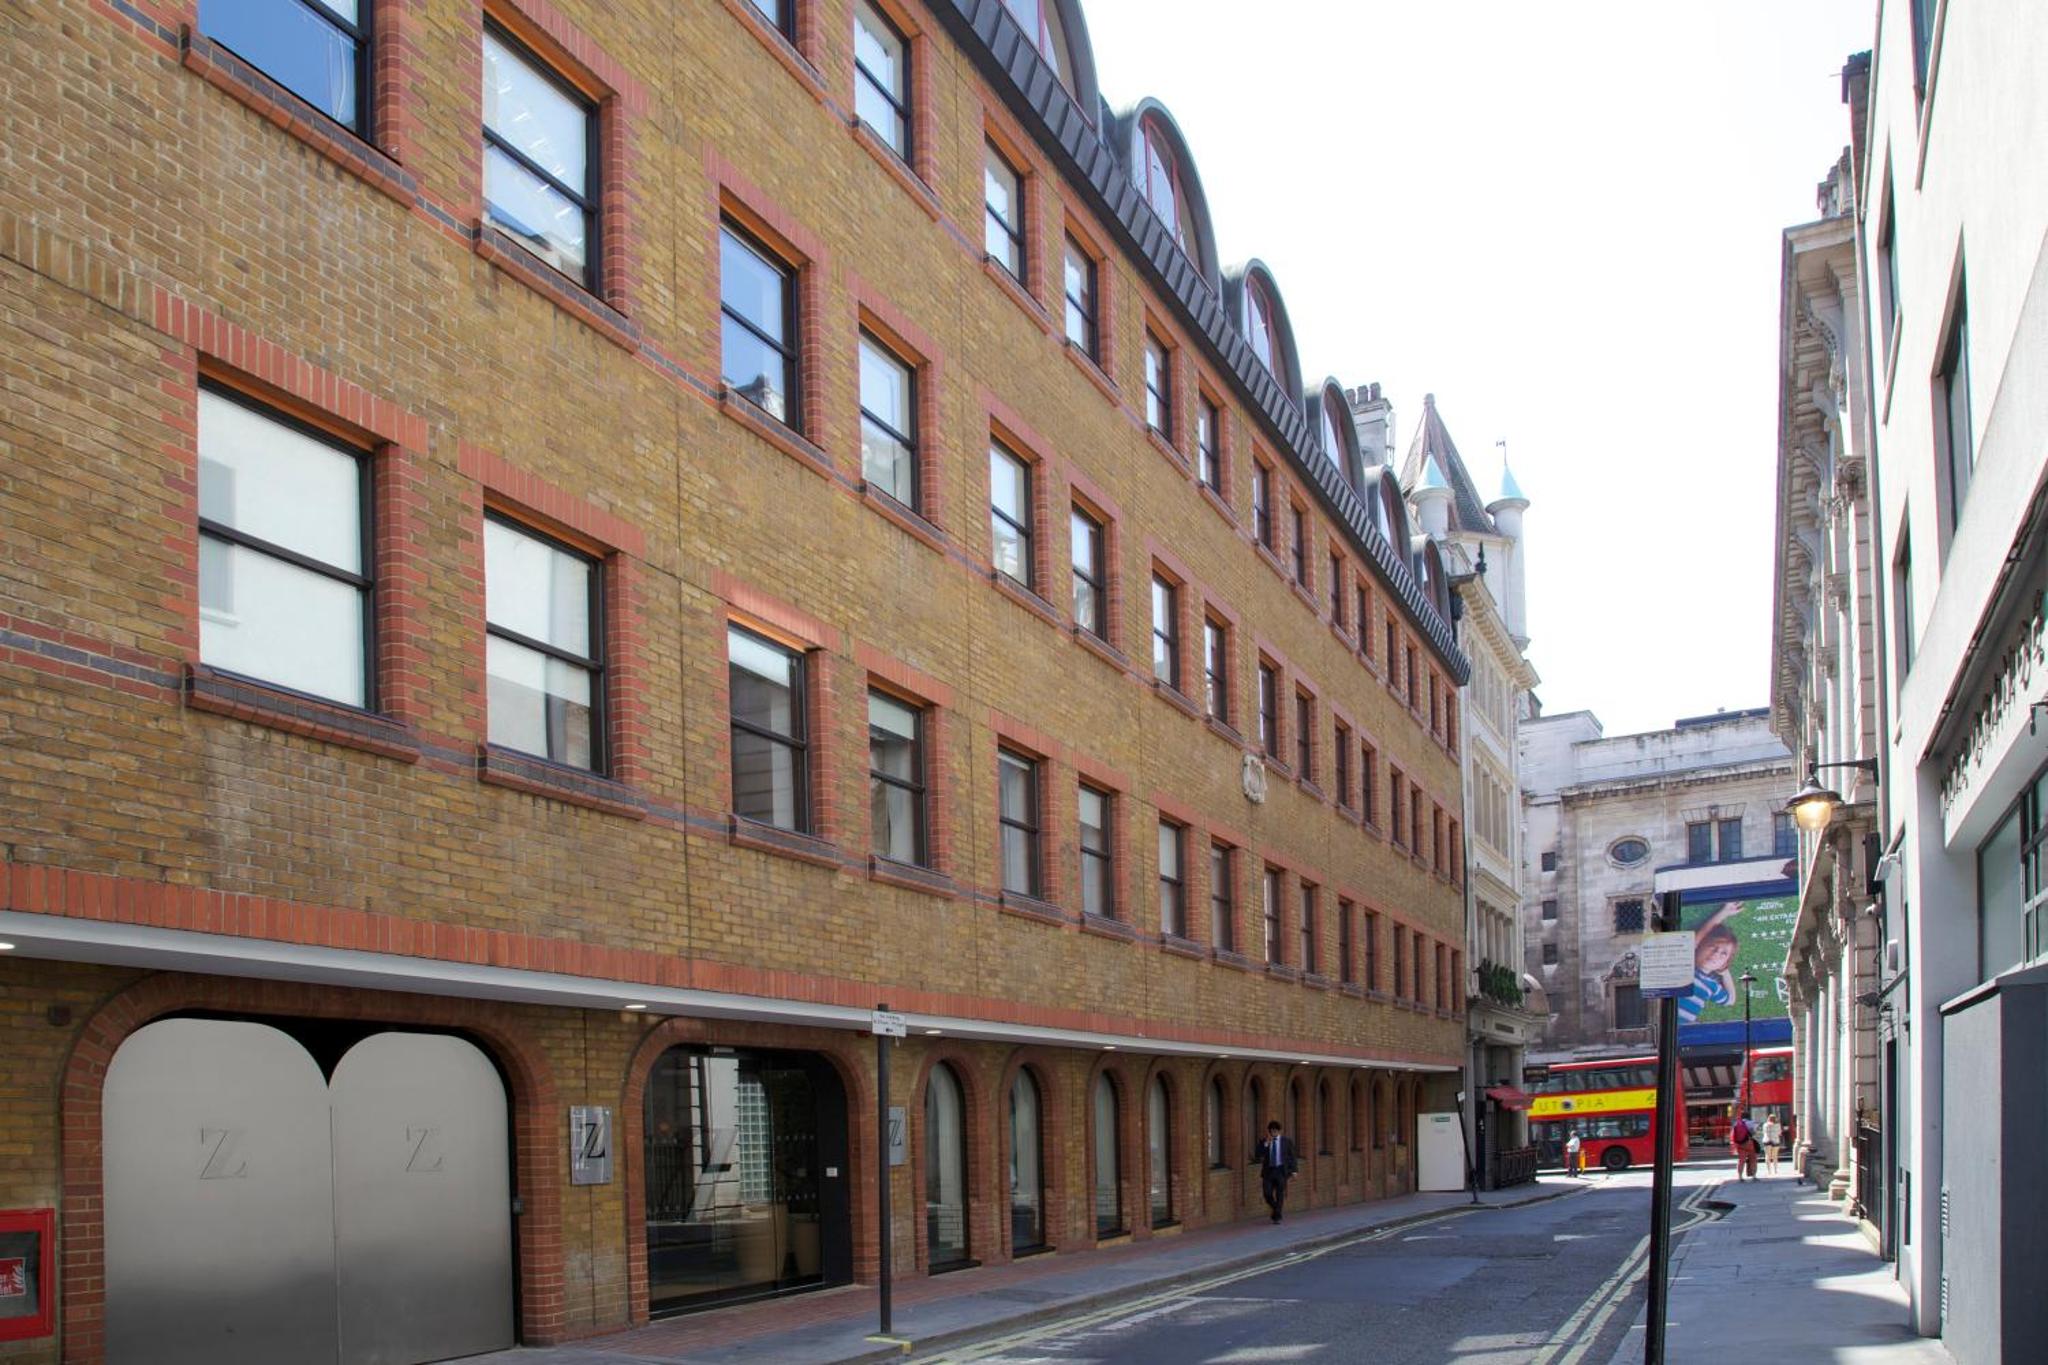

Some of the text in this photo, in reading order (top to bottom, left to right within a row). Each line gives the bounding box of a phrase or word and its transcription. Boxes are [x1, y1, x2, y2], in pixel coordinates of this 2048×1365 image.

[199, 1128, 247, 1180] Z
[405, 1126, 443, 1172] Z
[579, 1122, 606, 1158] Z
